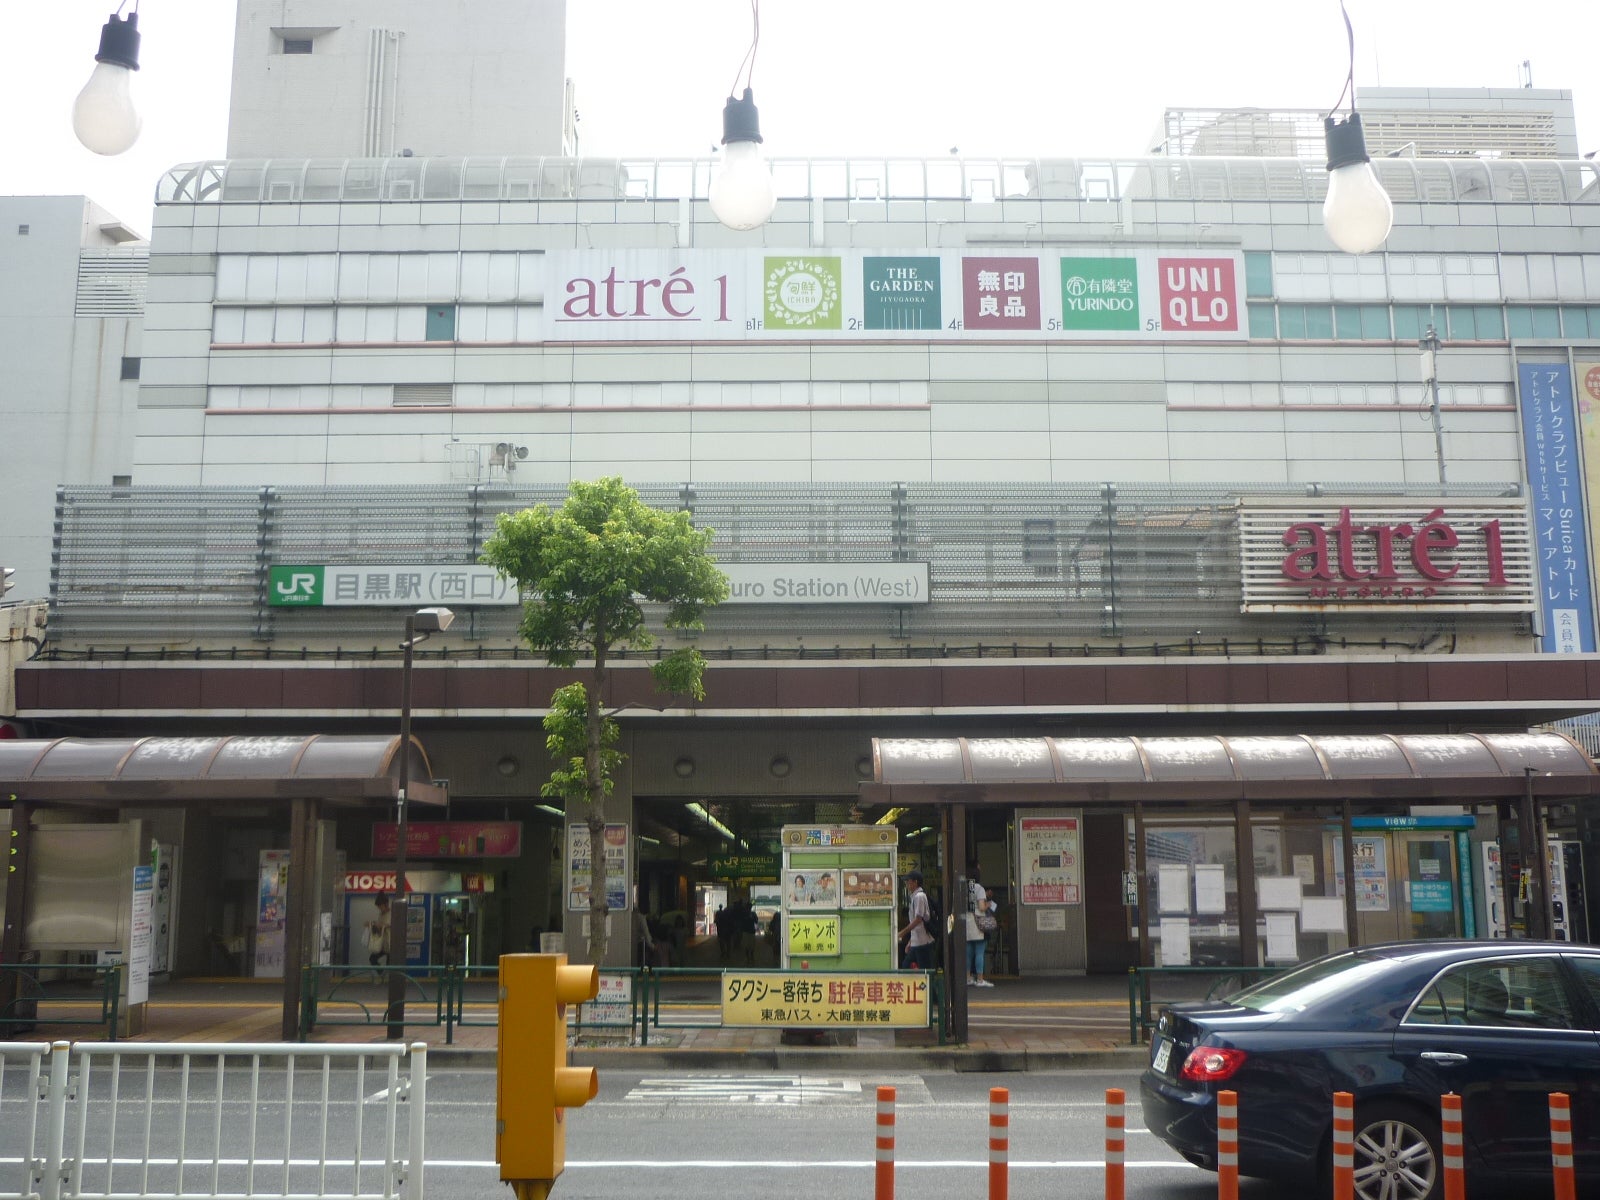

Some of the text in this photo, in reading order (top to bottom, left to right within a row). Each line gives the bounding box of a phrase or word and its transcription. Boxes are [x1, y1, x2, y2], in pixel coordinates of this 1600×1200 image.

[886, 268, 918, 279] THE
[977, 270, 1026, 292] 無印
[1166, 267, 1222, 292] UNI
[563, 266, 733, 322] atré 1
[869, 279, 935, 292] GARDEN
[880, 296, 926, 304] JIYUGAOKA
[978, 296, 1026, 318] 良品
[1067, 298, 1134, 311] YURINDO
[1169, 297, 1229, 327] QLO
[746, 318, 763, 331] B1F
[848, 318, 863, 331] 2F
[948, 319, 963, 331] 4F
[1047, 319, 1062, 331] 5F
[1146, 320, 1161, 332] 5F
[1281, 506, 1511, 588] atré 1
[1540, 508, 1560, 600] マイアトレ
[277, 573, 316, 594] JR
[730, 575, 919, 598] uro Station (West)
[791, 921, 836, 939] ジャンボ
[728, 979, 924, 1005] タクシー客待ち 駐停車禁止
[760, 1008, 891, 1022] 東急バス・大崎警察署
